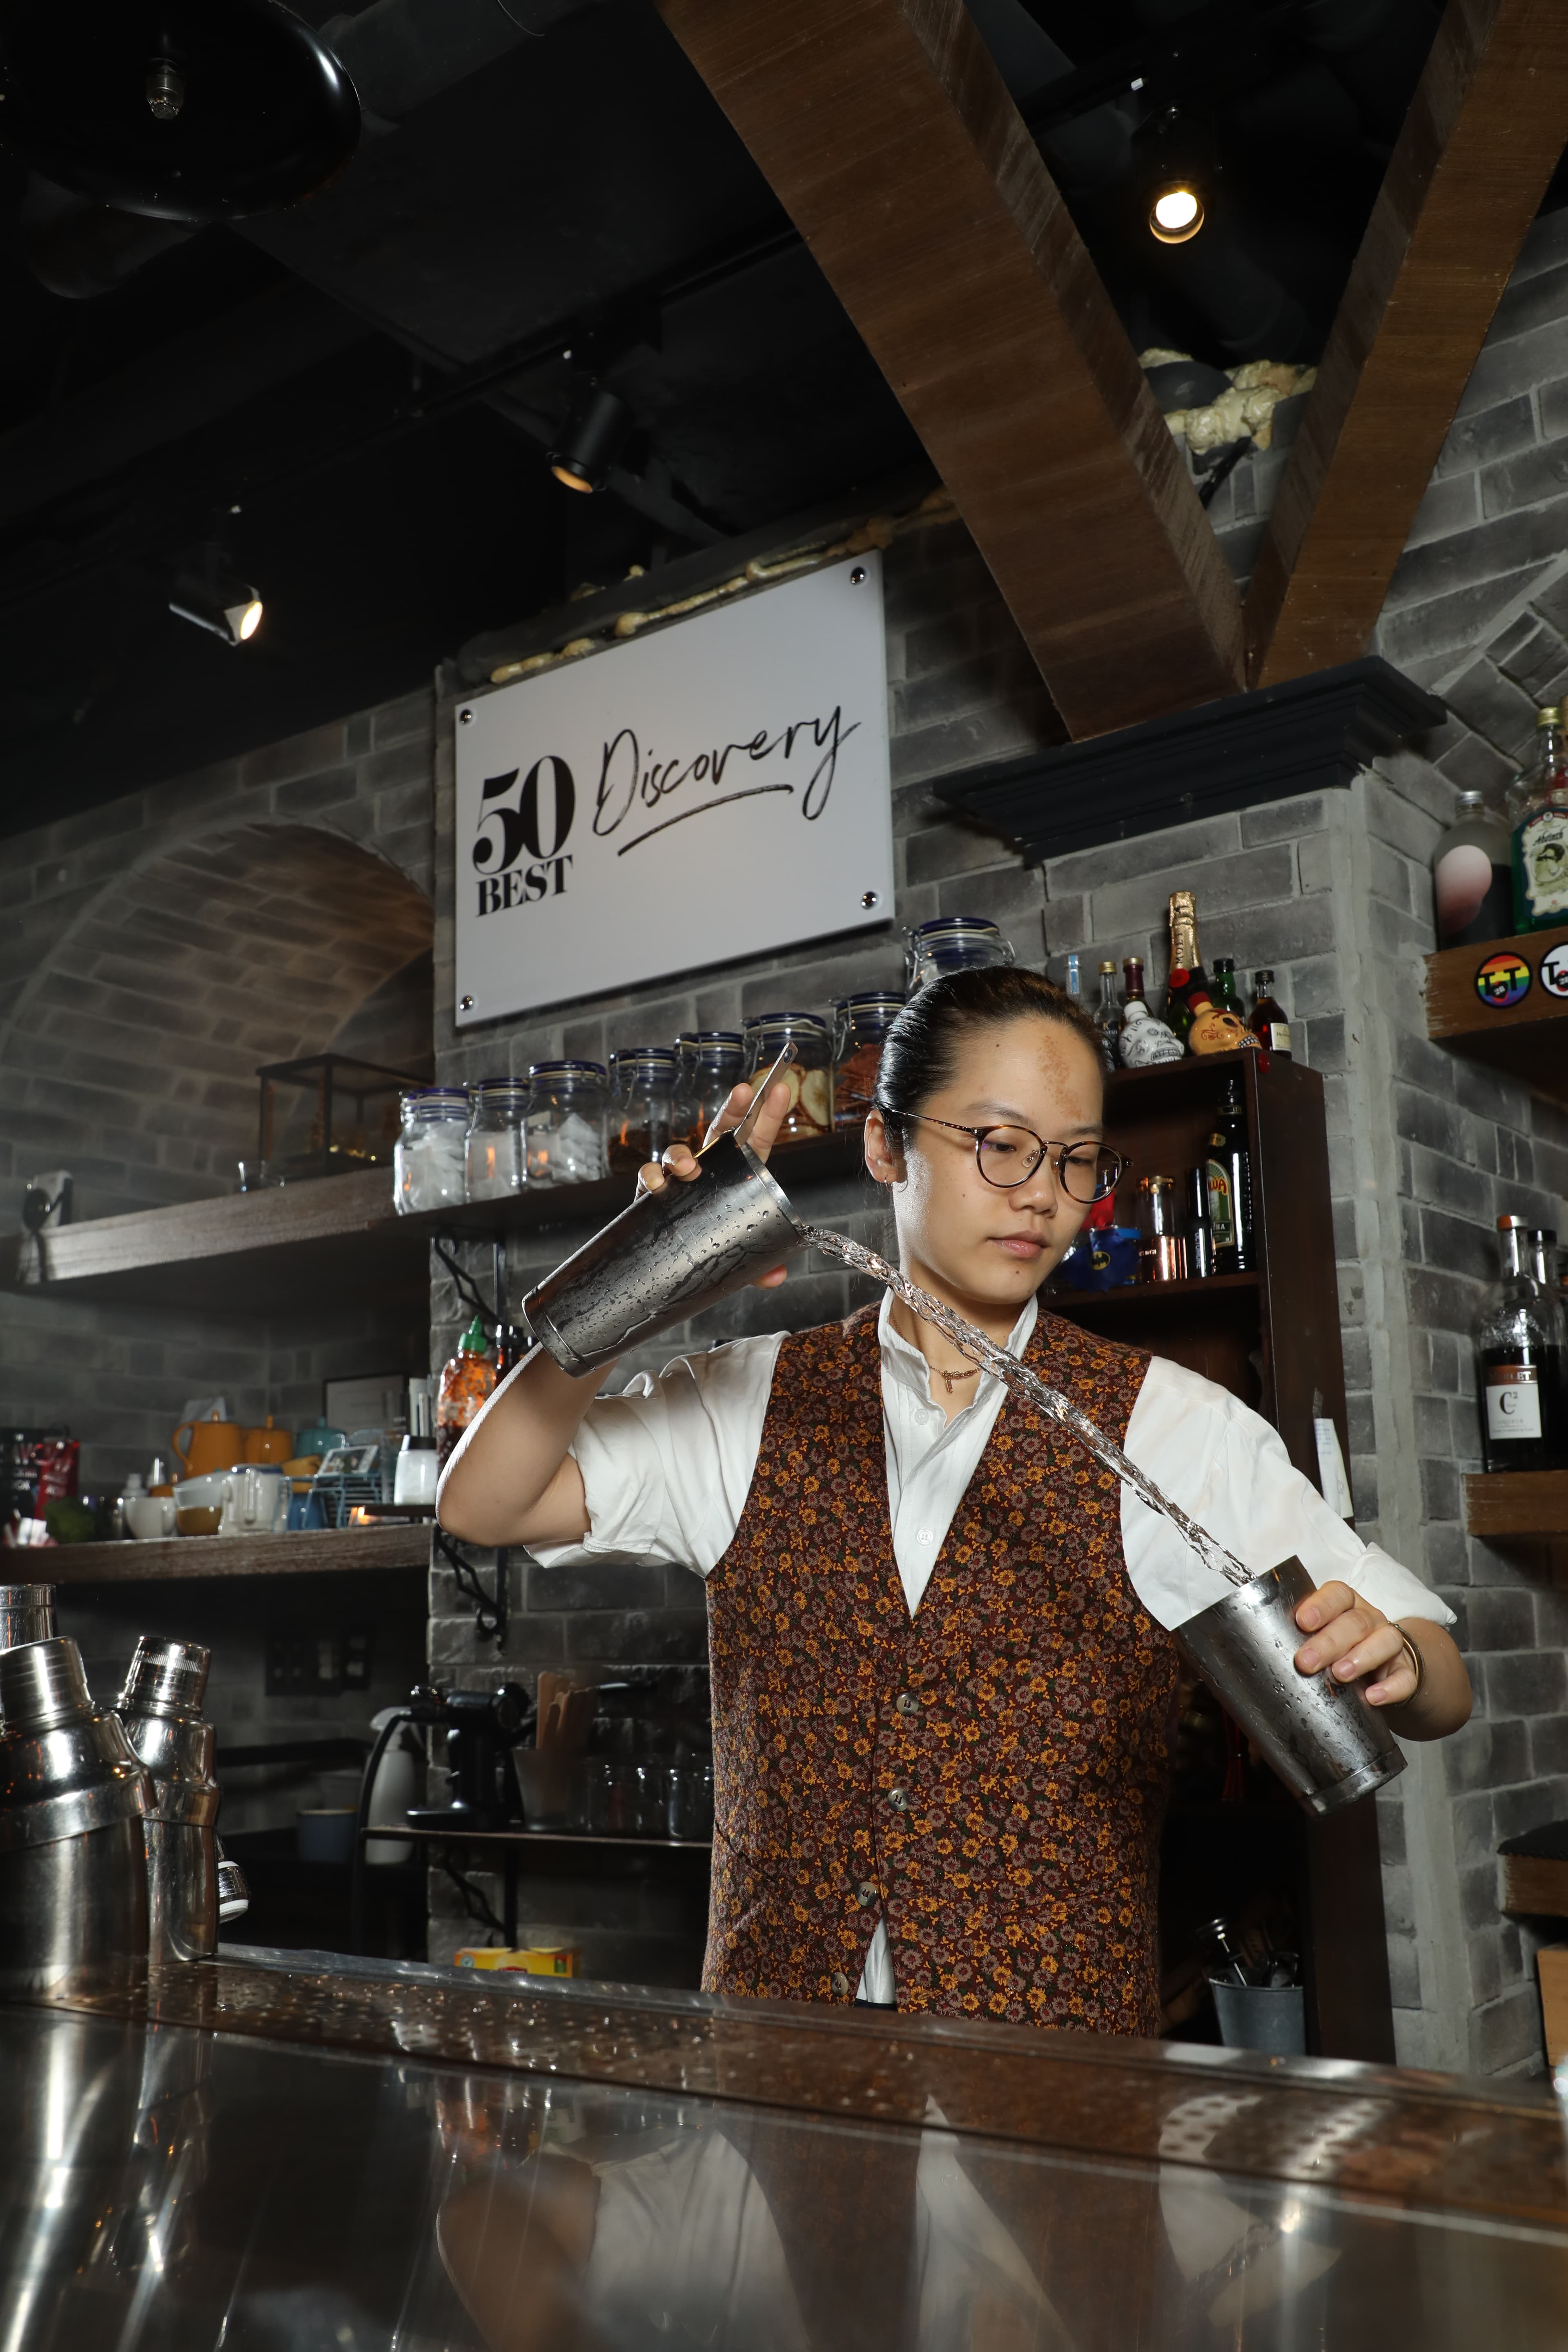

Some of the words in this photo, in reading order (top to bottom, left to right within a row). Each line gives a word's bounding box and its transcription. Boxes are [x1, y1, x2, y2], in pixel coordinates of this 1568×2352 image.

[472, 755, 576, 875] 50
[592, 706, 862, 836] Discovery
[475, 854, 573, 917] BEST
